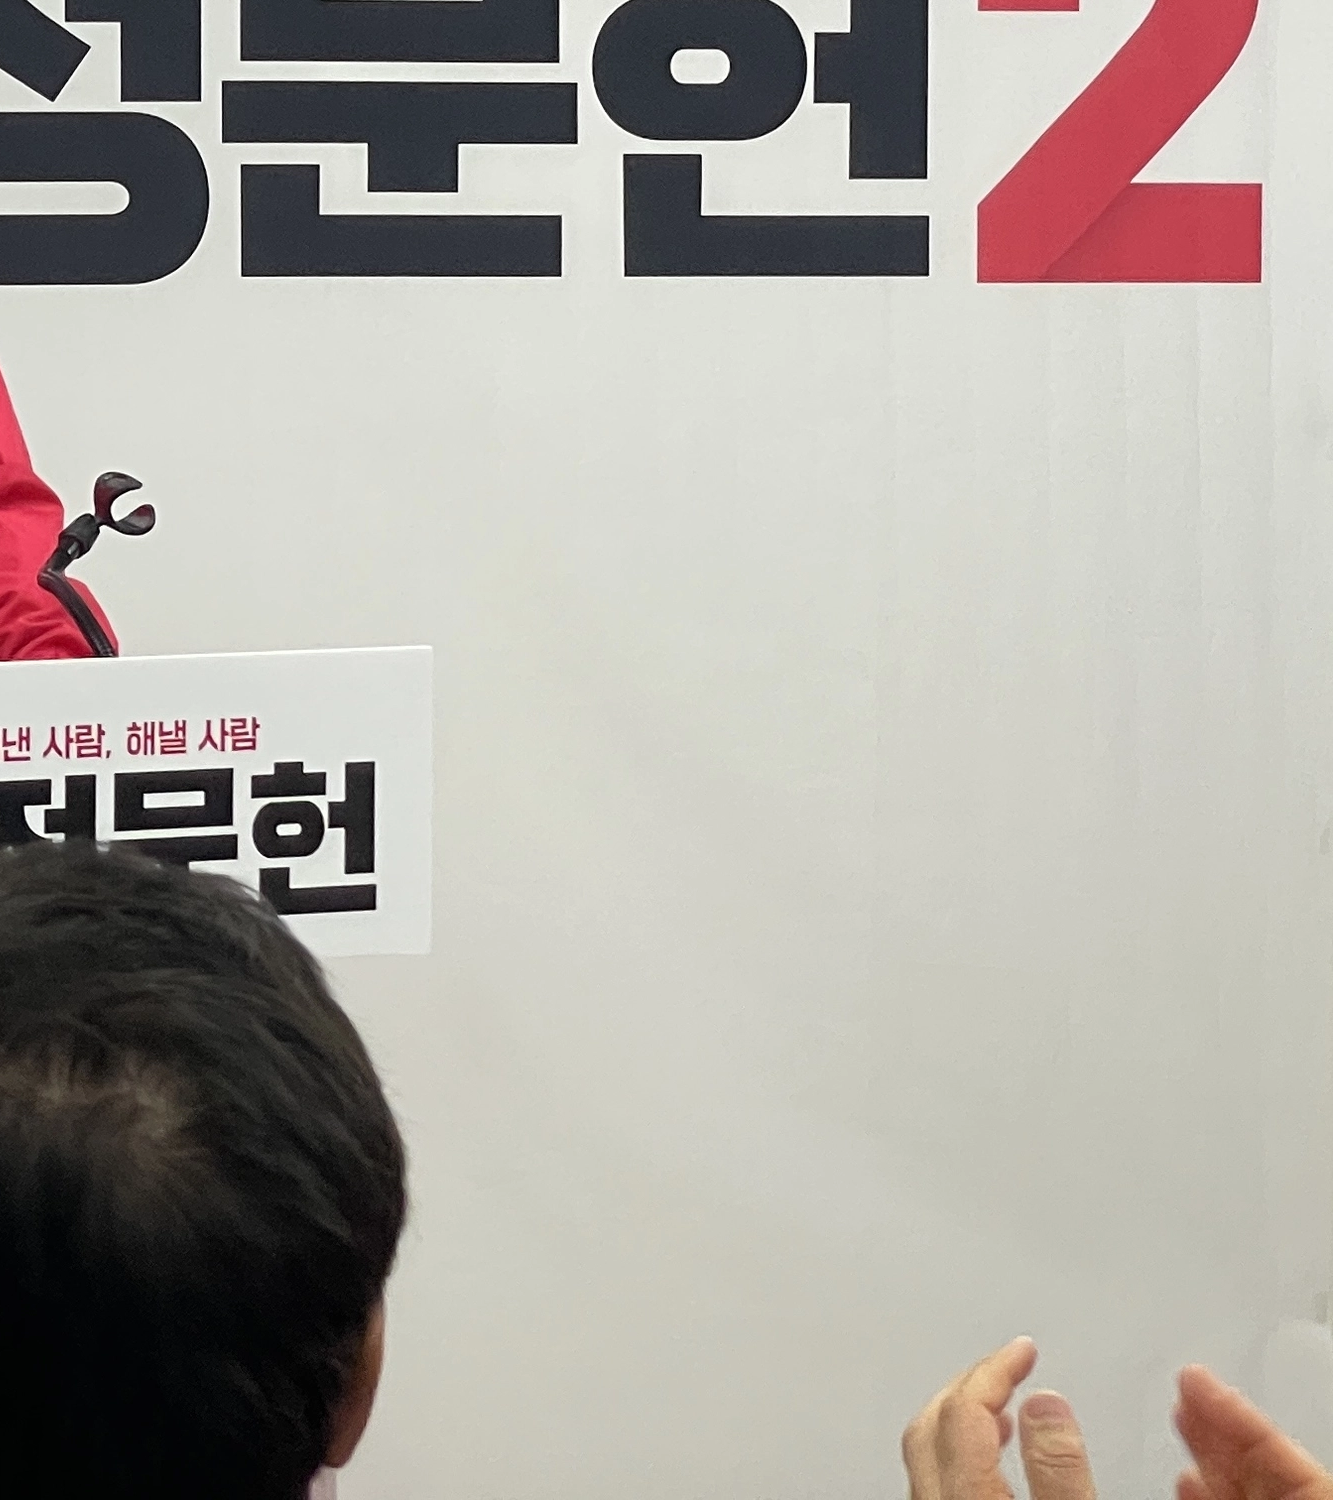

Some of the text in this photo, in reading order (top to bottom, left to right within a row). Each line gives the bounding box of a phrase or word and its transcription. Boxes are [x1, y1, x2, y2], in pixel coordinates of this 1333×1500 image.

[42, 723, 111, 760] 사람,
[126, 719, 188, 756] 해낼
[198, 716, 260, 753] 사람
